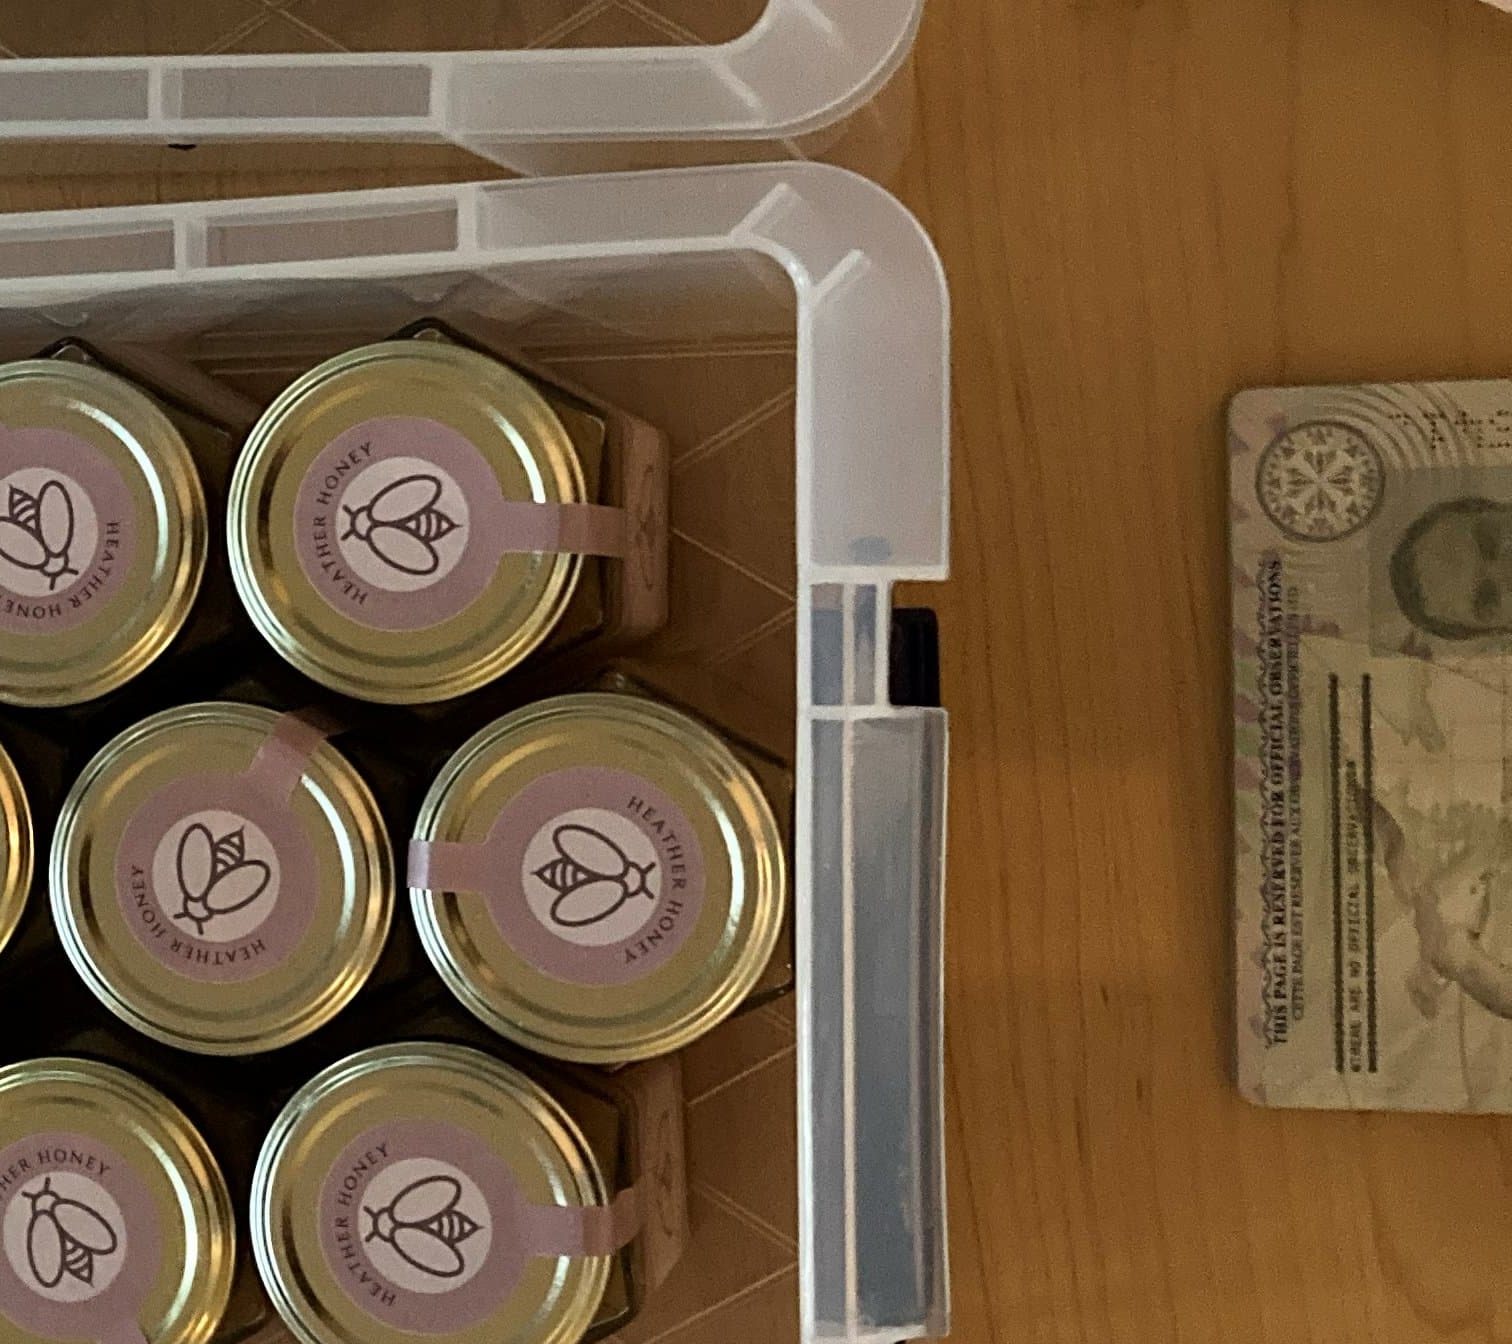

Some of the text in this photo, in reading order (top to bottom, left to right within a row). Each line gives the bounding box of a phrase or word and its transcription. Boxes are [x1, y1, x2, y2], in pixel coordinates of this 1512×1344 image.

[68, 521, 121, 609] HEATHER
[311, 440, 373, 606] HEATHER HONEY
[624, 795, 686, 965] HEATHER HONEY
[1267, 560, 1288, 1043] THIS PAGE IS RESERVED FOR OFFICIAL OBSERVATIONS
[130, 863, 266, 967] HEATHER HONEY
[38, 1147, 111, 1177] HONEY
[335, 1141, 397, 1308] HEATHER HONEY
